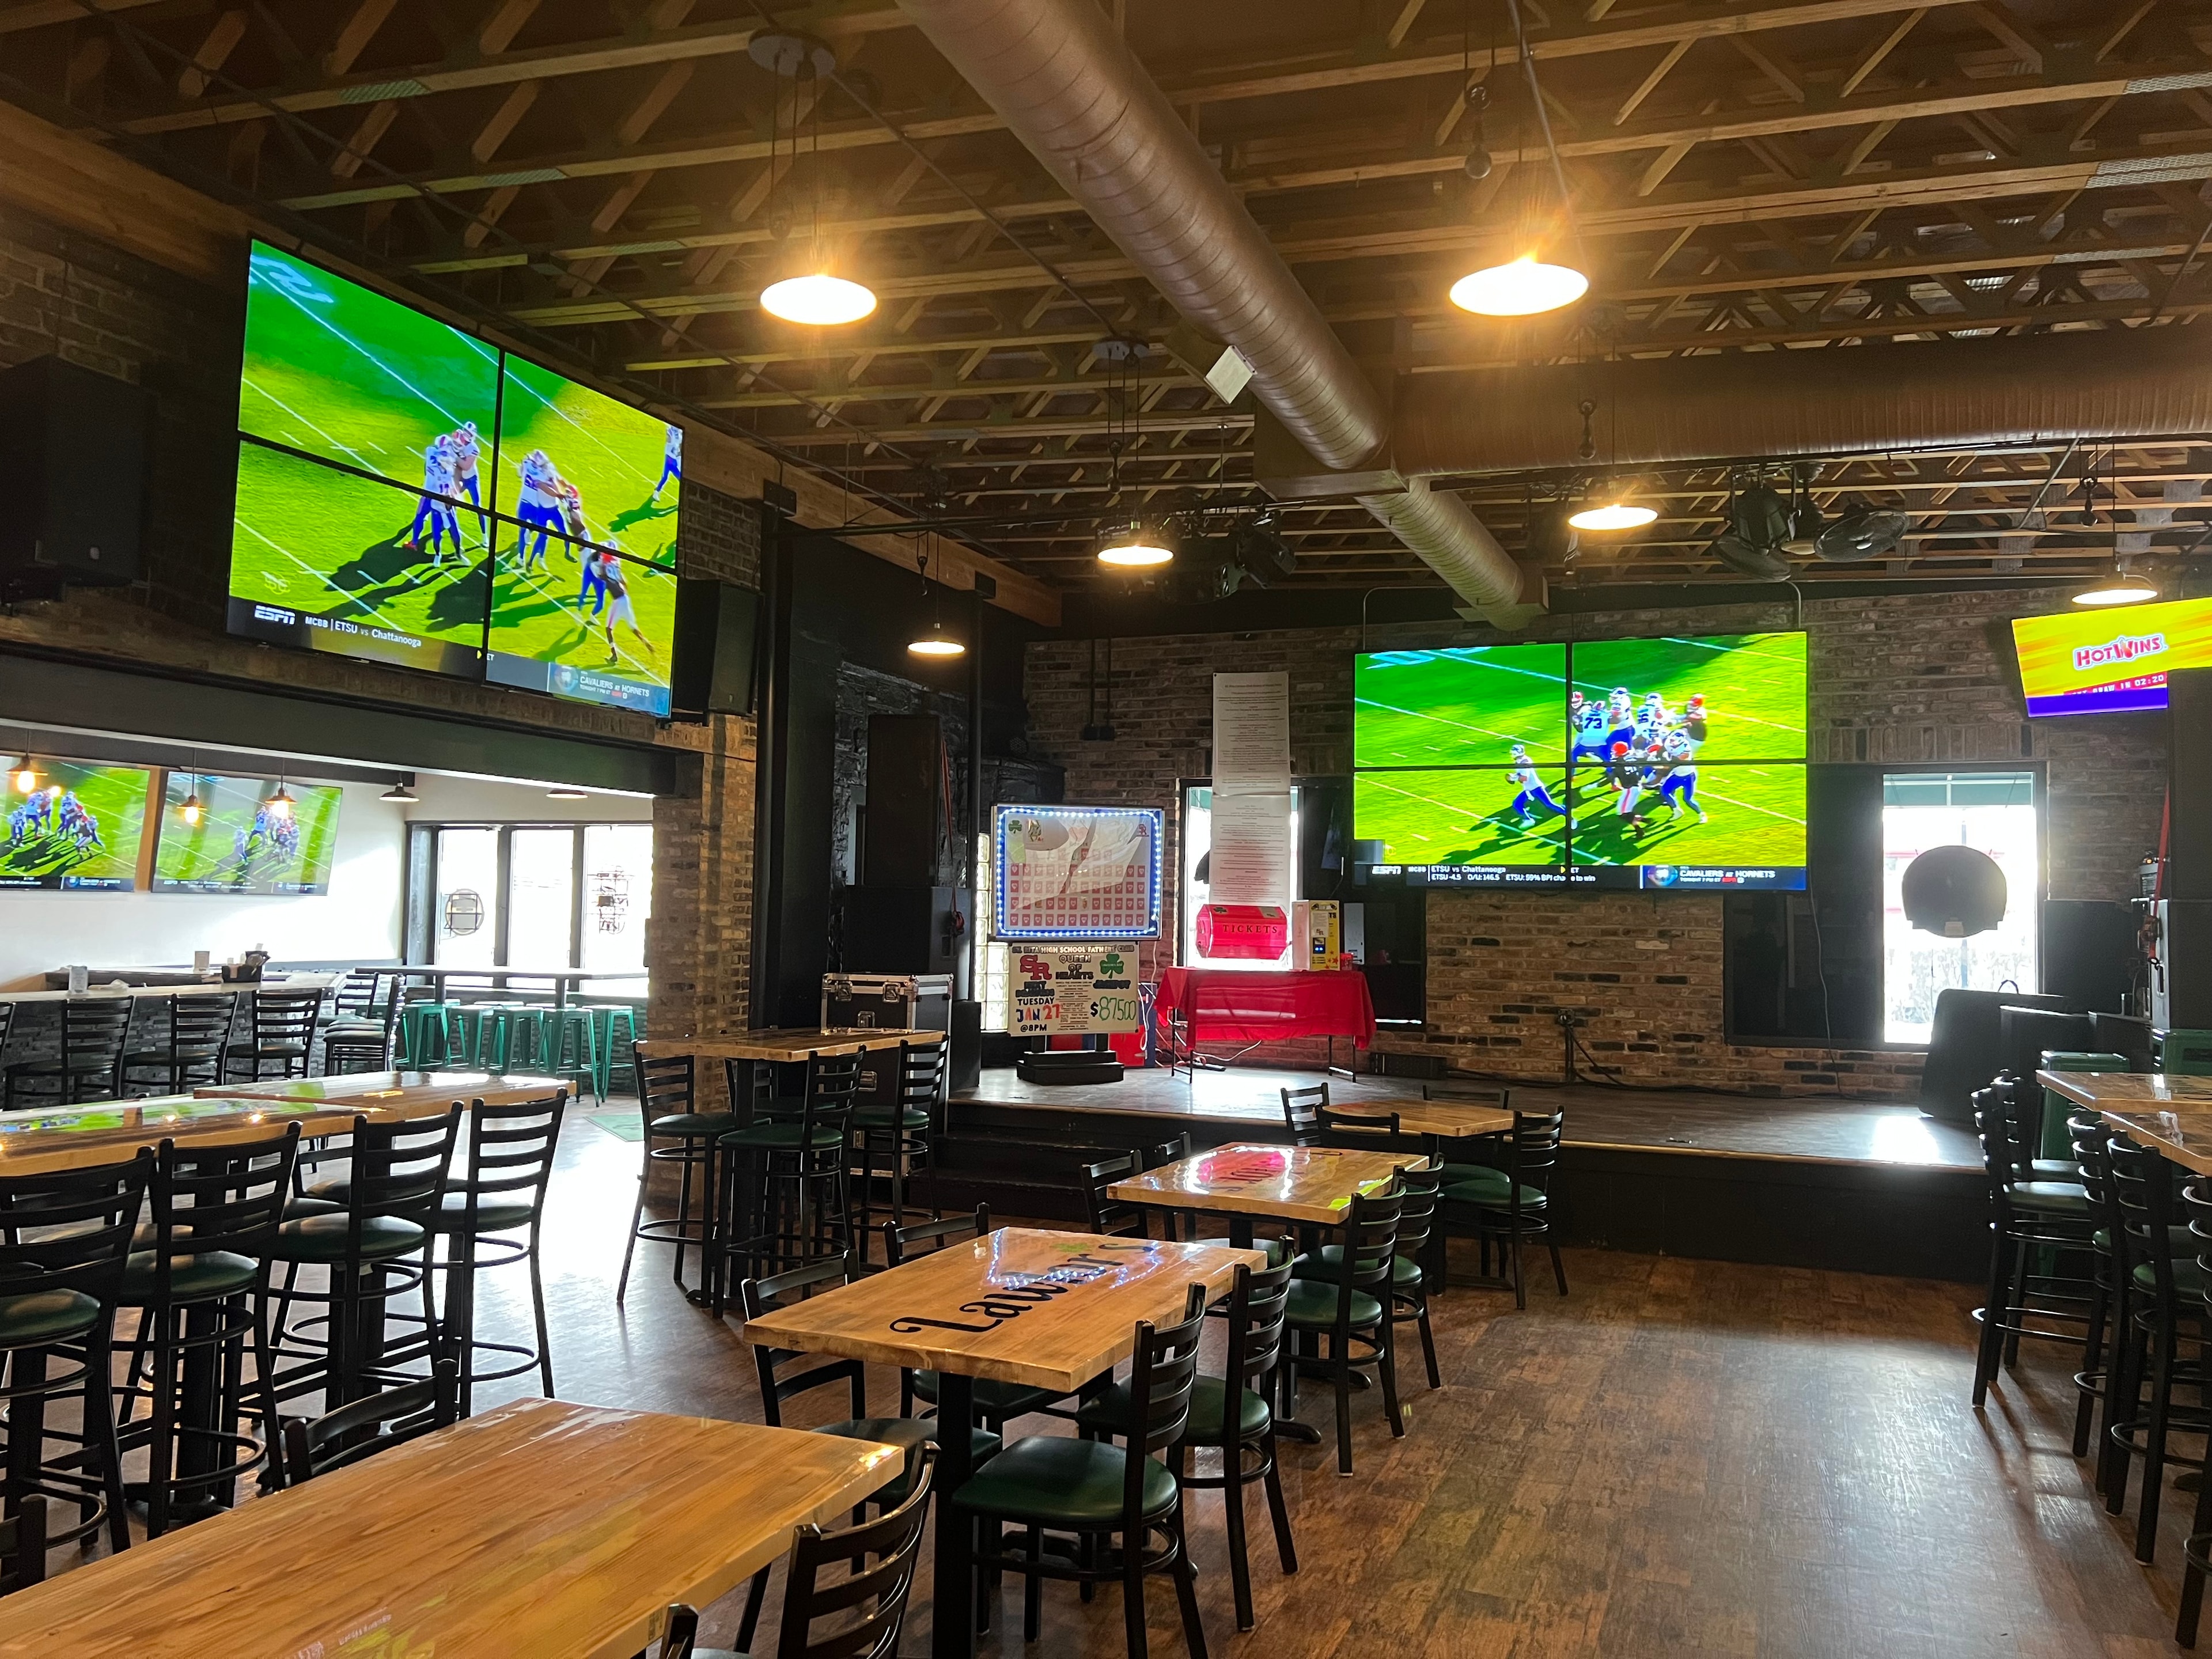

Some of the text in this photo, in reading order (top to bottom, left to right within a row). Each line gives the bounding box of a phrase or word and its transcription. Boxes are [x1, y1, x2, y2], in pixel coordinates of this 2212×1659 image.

[255, 605, 296, 625] ESPN
[305, 615, 422, 648] MCBB ETSU vs Chattanooga
[2135, 675, 2164, 686] 02:20
[580, 676, 613, 690] CAVALIERS
[622, 684, 650, 697] HORNETS
[1585, 717, 1603, 729] 73
[1372, 866, 1402, 874] ESPN
[1461, 866, 1506, 874] Chattanooga
[1735, 870, 1775, 878] HORNETS
[1222, 924, 1278, 934] TICKETS
[1059, 945, 1086, 953] SCHOOL
[1059, 955, 1092, 964] QUEEN
[1020, 955, 1052, 980] SR
[1068, 964, 1082, 972] OF
[1055, 971, 1094, 980] HEARTS
[1017, 997, 1055, 1006] TUESDAY
[1043, 1003, 1060, 1020] 27
[1020, 1024, 1047, 1033] @8PM
